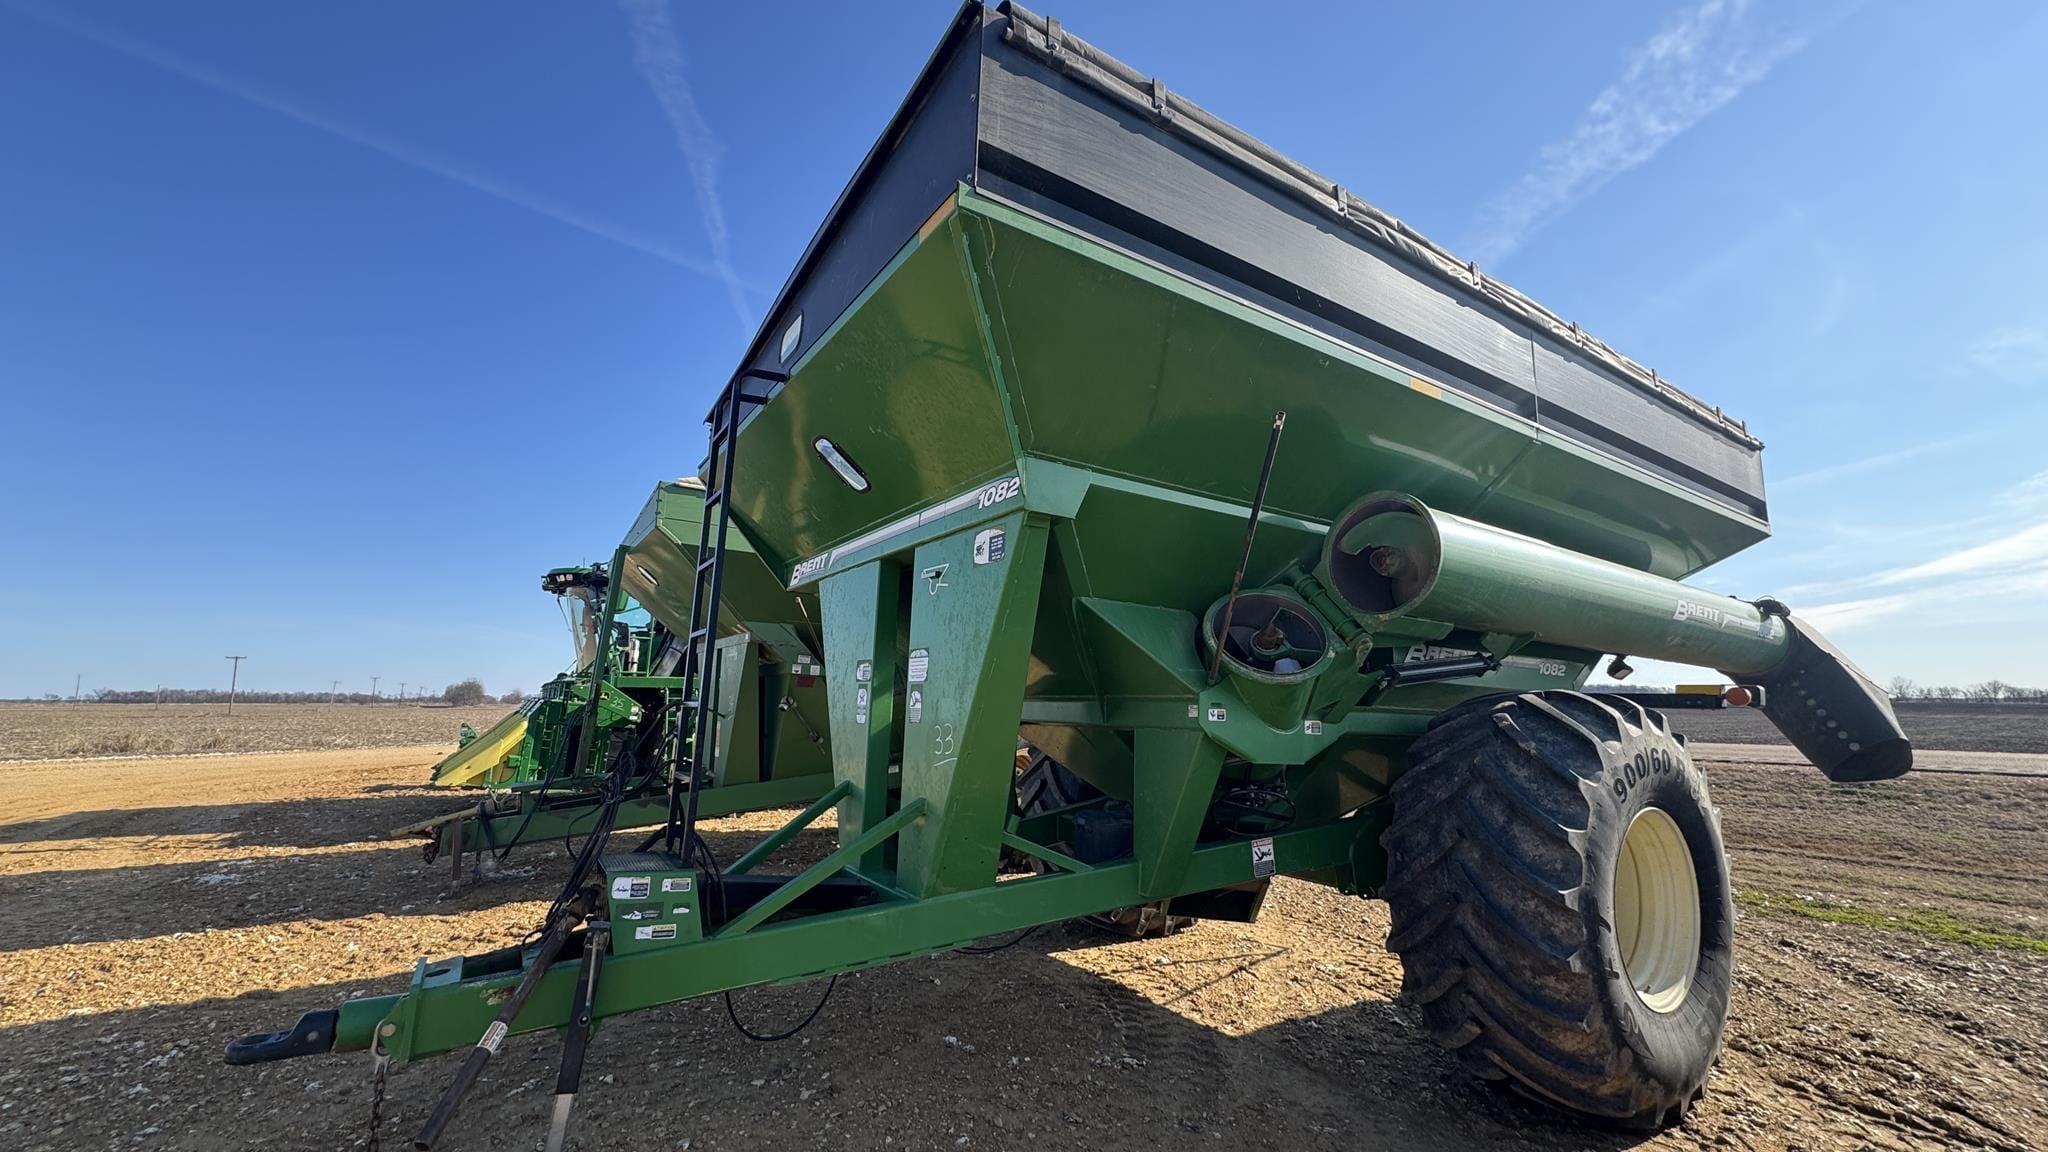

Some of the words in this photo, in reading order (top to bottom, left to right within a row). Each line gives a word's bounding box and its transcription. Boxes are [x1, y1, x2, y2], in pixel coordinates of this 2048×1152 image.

[790, 553, 829, 586] BRENT
[978, 476, 1020, 509] 1082
[1673, 600, 1720, 621] BRENT
[1538, 662, 1567, 677] 1082
[934, 722, 954, 755] 33
[1613, 747, 1672, 803] 900/60
